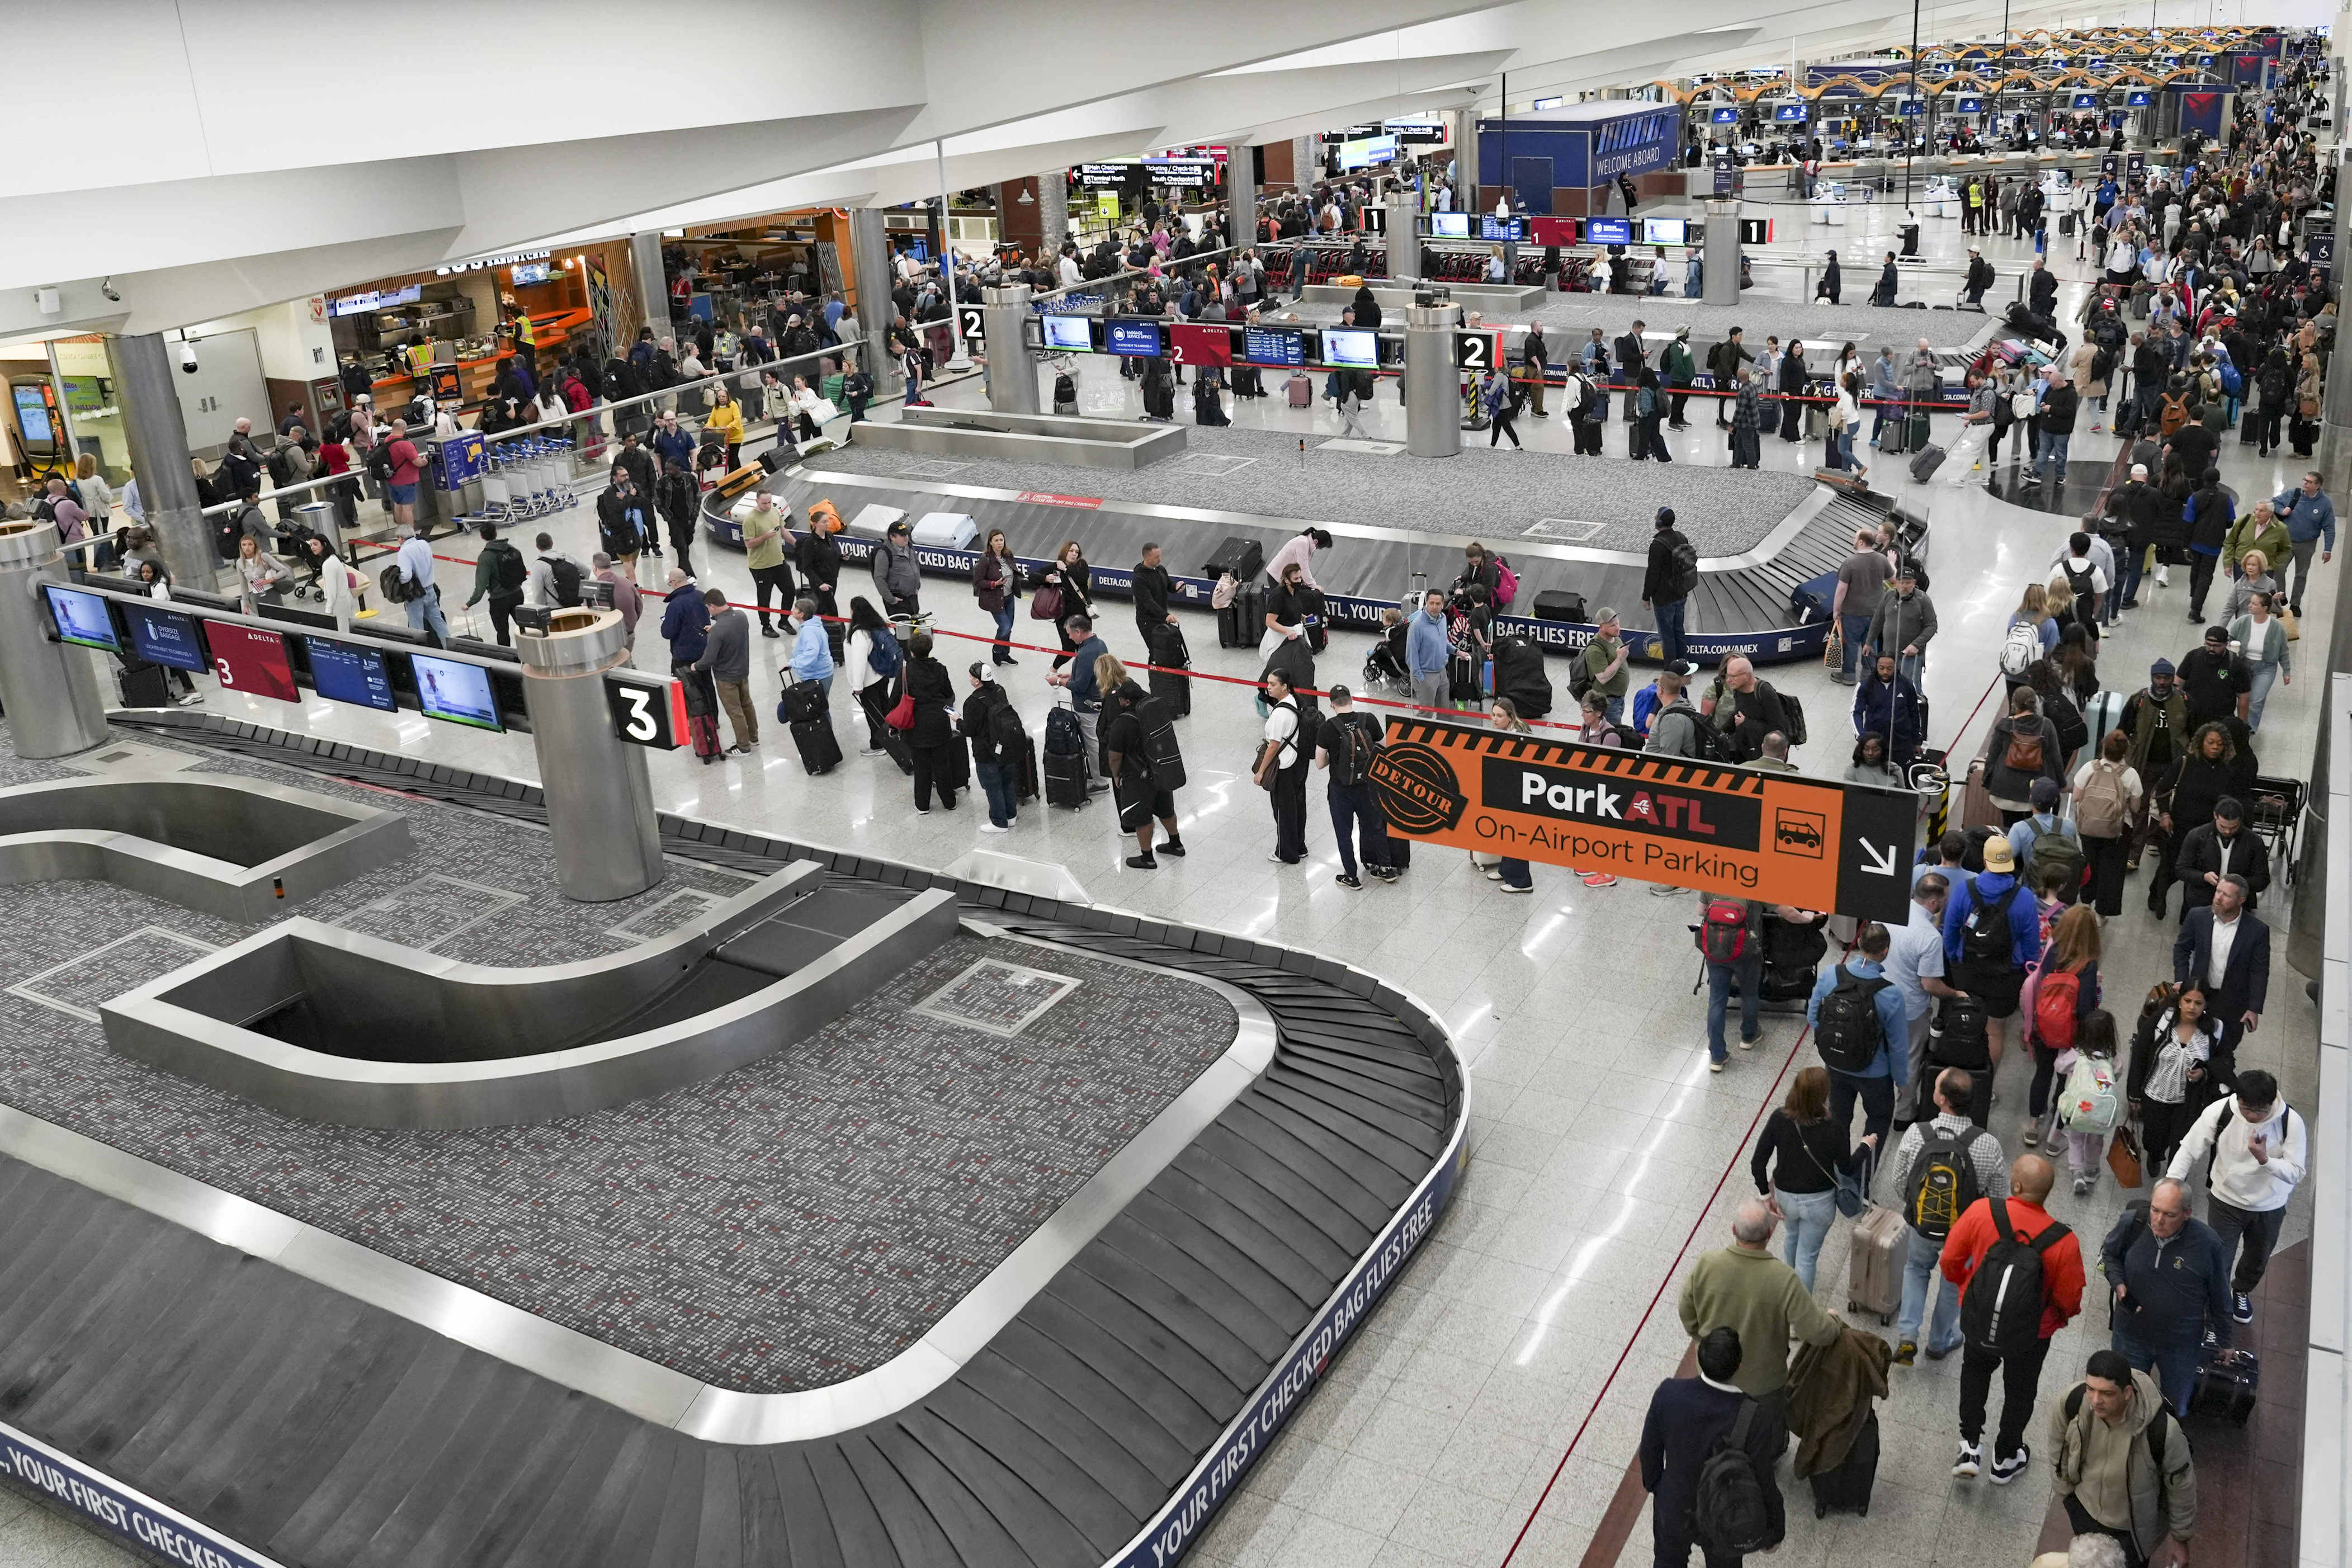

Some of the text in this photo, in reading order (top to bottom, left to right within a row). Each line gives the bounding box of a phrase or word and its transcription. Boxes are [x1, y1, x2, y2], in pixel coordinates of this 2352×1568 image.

[1597, 147, 1660, 176] WELCOME ABOARD
[1371, 211, 1378, 229] 1
[1750, 222, 1757, 242] 1
[1533, 233, 1538, 244] 1
[487, 251, 550, 267] SANDWICHES
[965, 311, 983, 337] 2
[1173, 346, 1184, 362] 2
[1465, 337, 1485, 367] 2
[1859, 389, 1874, 399] FR
[838, 541, 867, 558] YOUR
[919, 551, 946, 567] CKED
[948, 557, 970, 571] BAG
[158, 626, 179, 634] OVERSIZE
[159, 632, 181, 641] BAGGAGE
[253, 634, 274, 643] DELTA
[1496, 621, 1526, 638] BAG
[1528, 625, 1566, 644] FLIES
[217, 658, 233, 684] 3
[619, 687, 657, 740] 3
[1375, 762, 1452, 814] DETOUR
[1475, 815, 1758, 888] On-Airport Parking
[1152, 1485, 1208, 1568] YOUR
[1211, 1416, 1258, 1501] FIRST
[1261, 1326, 1331, 1433] CHECKED
[1334, 1282, 1363, 1340] BAG
[1366, 1234, 1400, 1299] FLIES
[7, 1446, 72, 1501] YOUR
[69, 1476, 129, 1531] FIRST
